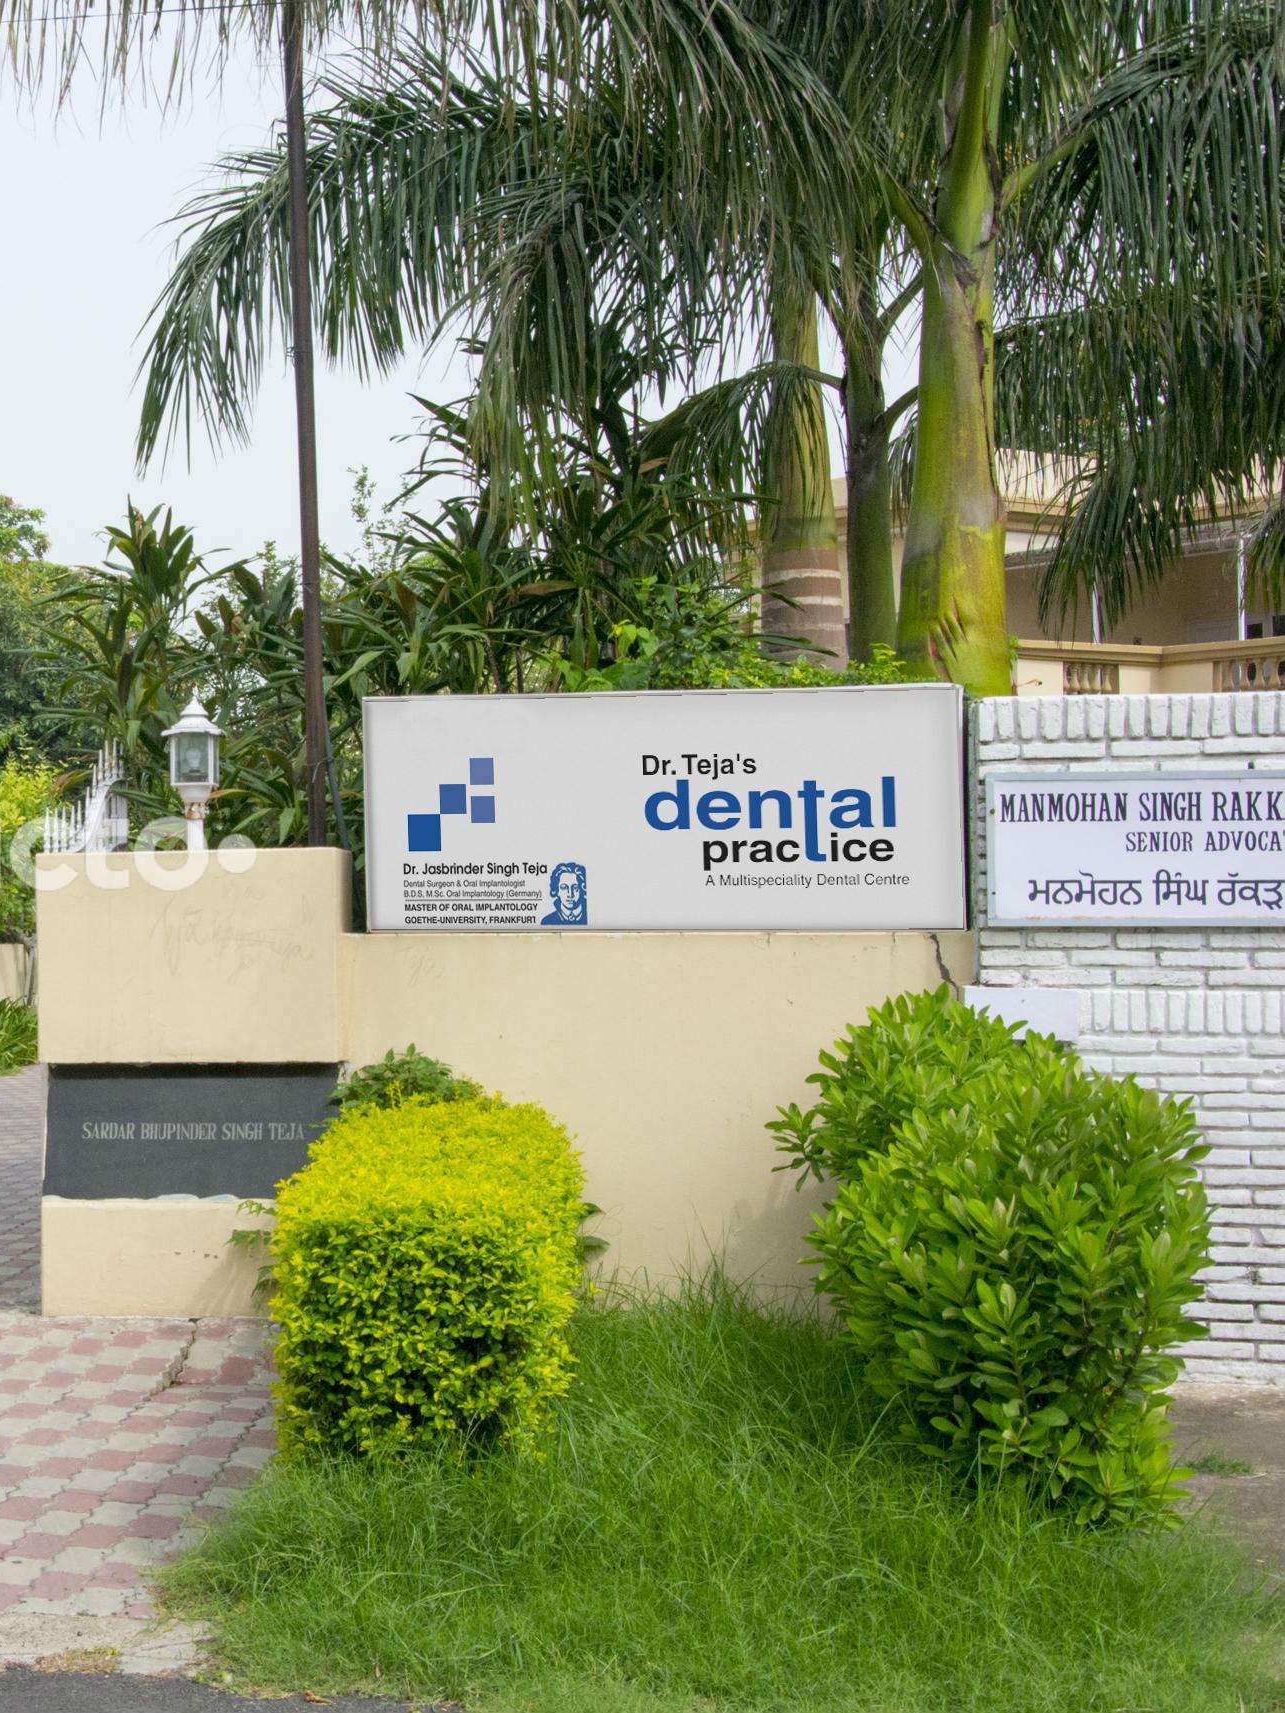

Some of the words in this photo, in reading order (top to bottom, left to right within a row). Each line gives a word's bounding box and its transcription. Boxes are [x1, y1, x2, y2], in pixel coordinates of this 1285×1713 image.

[641, 753, 677, 776] Dr.
[681, 753, 757, 780] Teja's
[644, 776, 897, 831] dental
[1000, 793, 1128, 823] MANMOHAN
[1139, 792, 1202, 822] SINGH
[1211, 791, 1285, 821] RAKK
[1126, 831, 1193, 852] SENIOR
[1204, 831, 1285, 852] ADVOCA
[702, 832, 895, 871] practice
[403, 863, 419, 875] Dr.
[422, 862, 484, 875] Jasbrinder
[486, 862, 520, 877] Singh
[522, 862, 548, 876] Teja
[403, 880, 425, 888] Dental
[426, 880, 455, 889] Surgeon
[456, 880, 462, 888] &
[463, 880, 478, 888] Oral
[479, 880, 526, 889] Implantologist
[705, 875, 715, 886] A
[719, 874, 812, 889] Multispeciality
[816, 873, 860, 886] Dental
[864, 873, 910, 886] Centre
[1152, 869, 1209, 906] ਸਿੰਘ
[426, 890, 445, 898] M.Sc.
[446, 890, 461, 898] Oral
[462, 889, 505, 899] Implantology
[506, 889, 542, 899] (Germany)
[404, 903, 437, 911] MASTER
[438, 903, 450, 911] OF
[451, 903, 474, 911] ORAL
[475, 903, 538, 911] IMPLANTOLOGY
[404, 916, 488, 925] GOETHE-UNIVERSITY,
[82, 1122, 135, 1140] SARDAR
[140, 1122, 216, 1140] BHUPINDER
[221, 1122, 263, 1140] SINGH
[268, 1122, 305, 1140] TEJA
